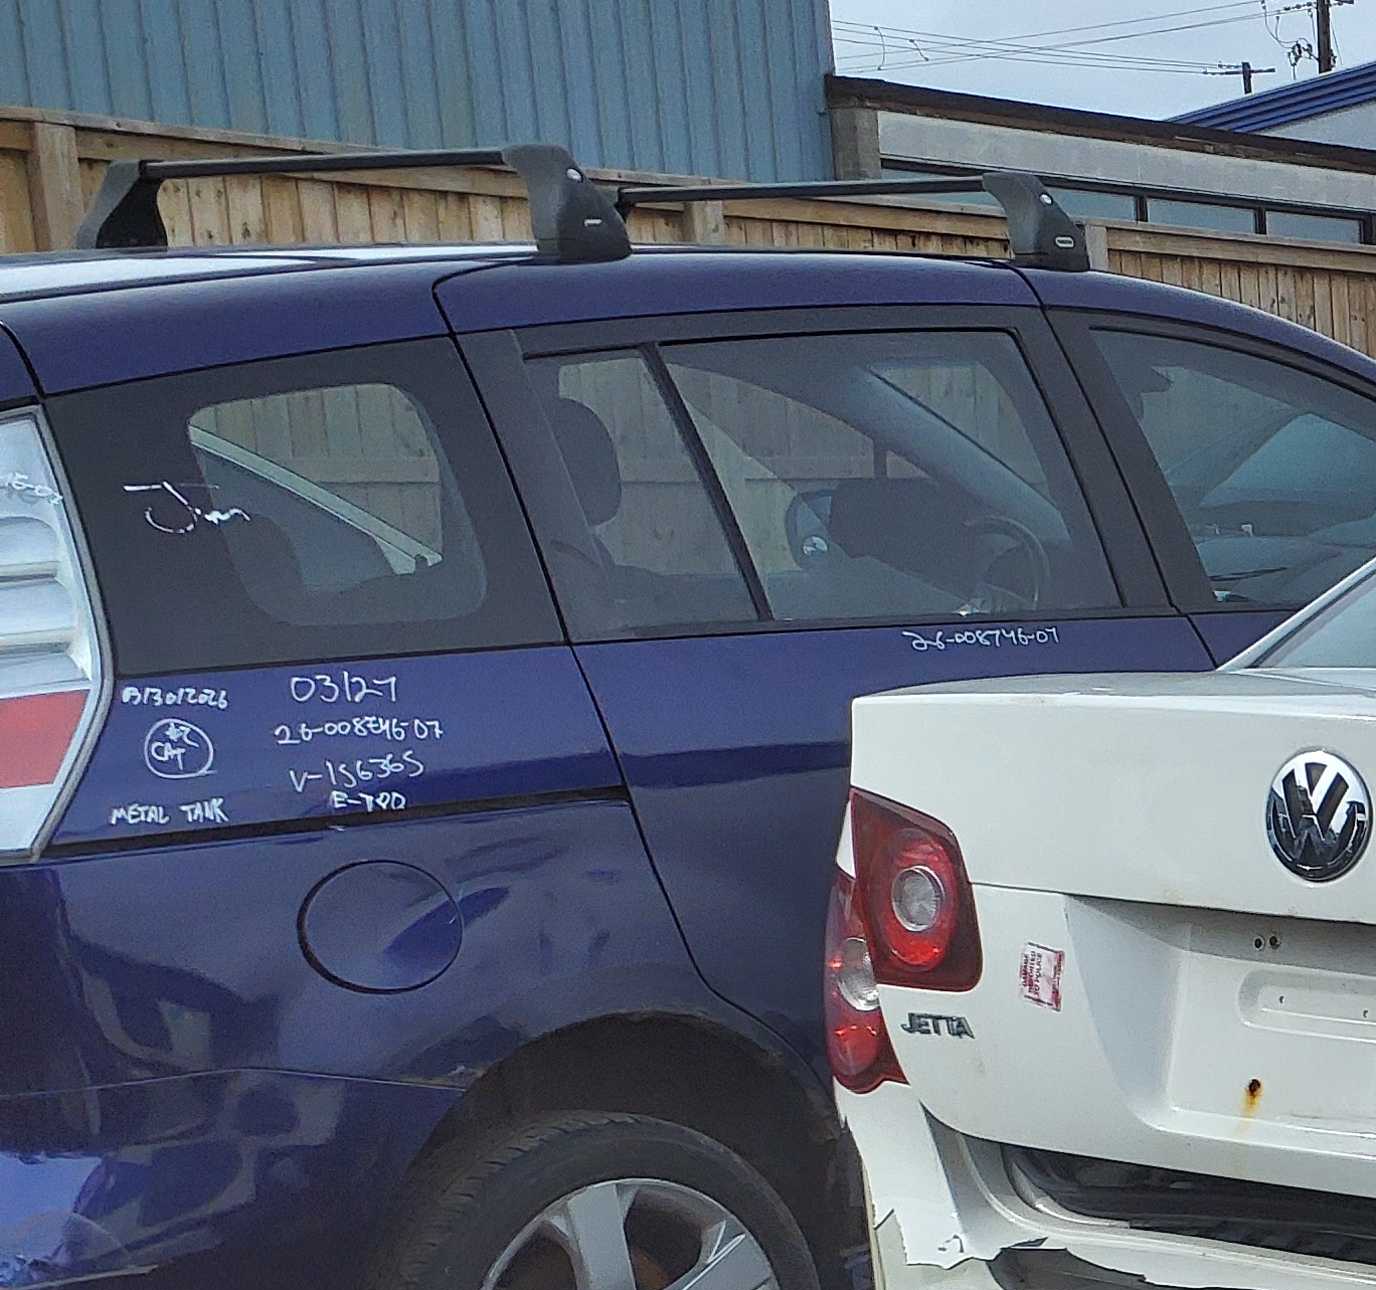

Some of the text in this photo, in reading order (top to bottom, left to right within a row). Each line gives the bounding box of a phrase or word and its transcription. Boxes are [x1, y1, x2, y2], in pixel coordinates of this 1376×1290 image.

[151, 741, 187, 771] CAT
[110, 797, 230, 825] METAL TANK
[1266, 748, 1374, 883] VW
[901, 1012, 976, 1039] JETTA
